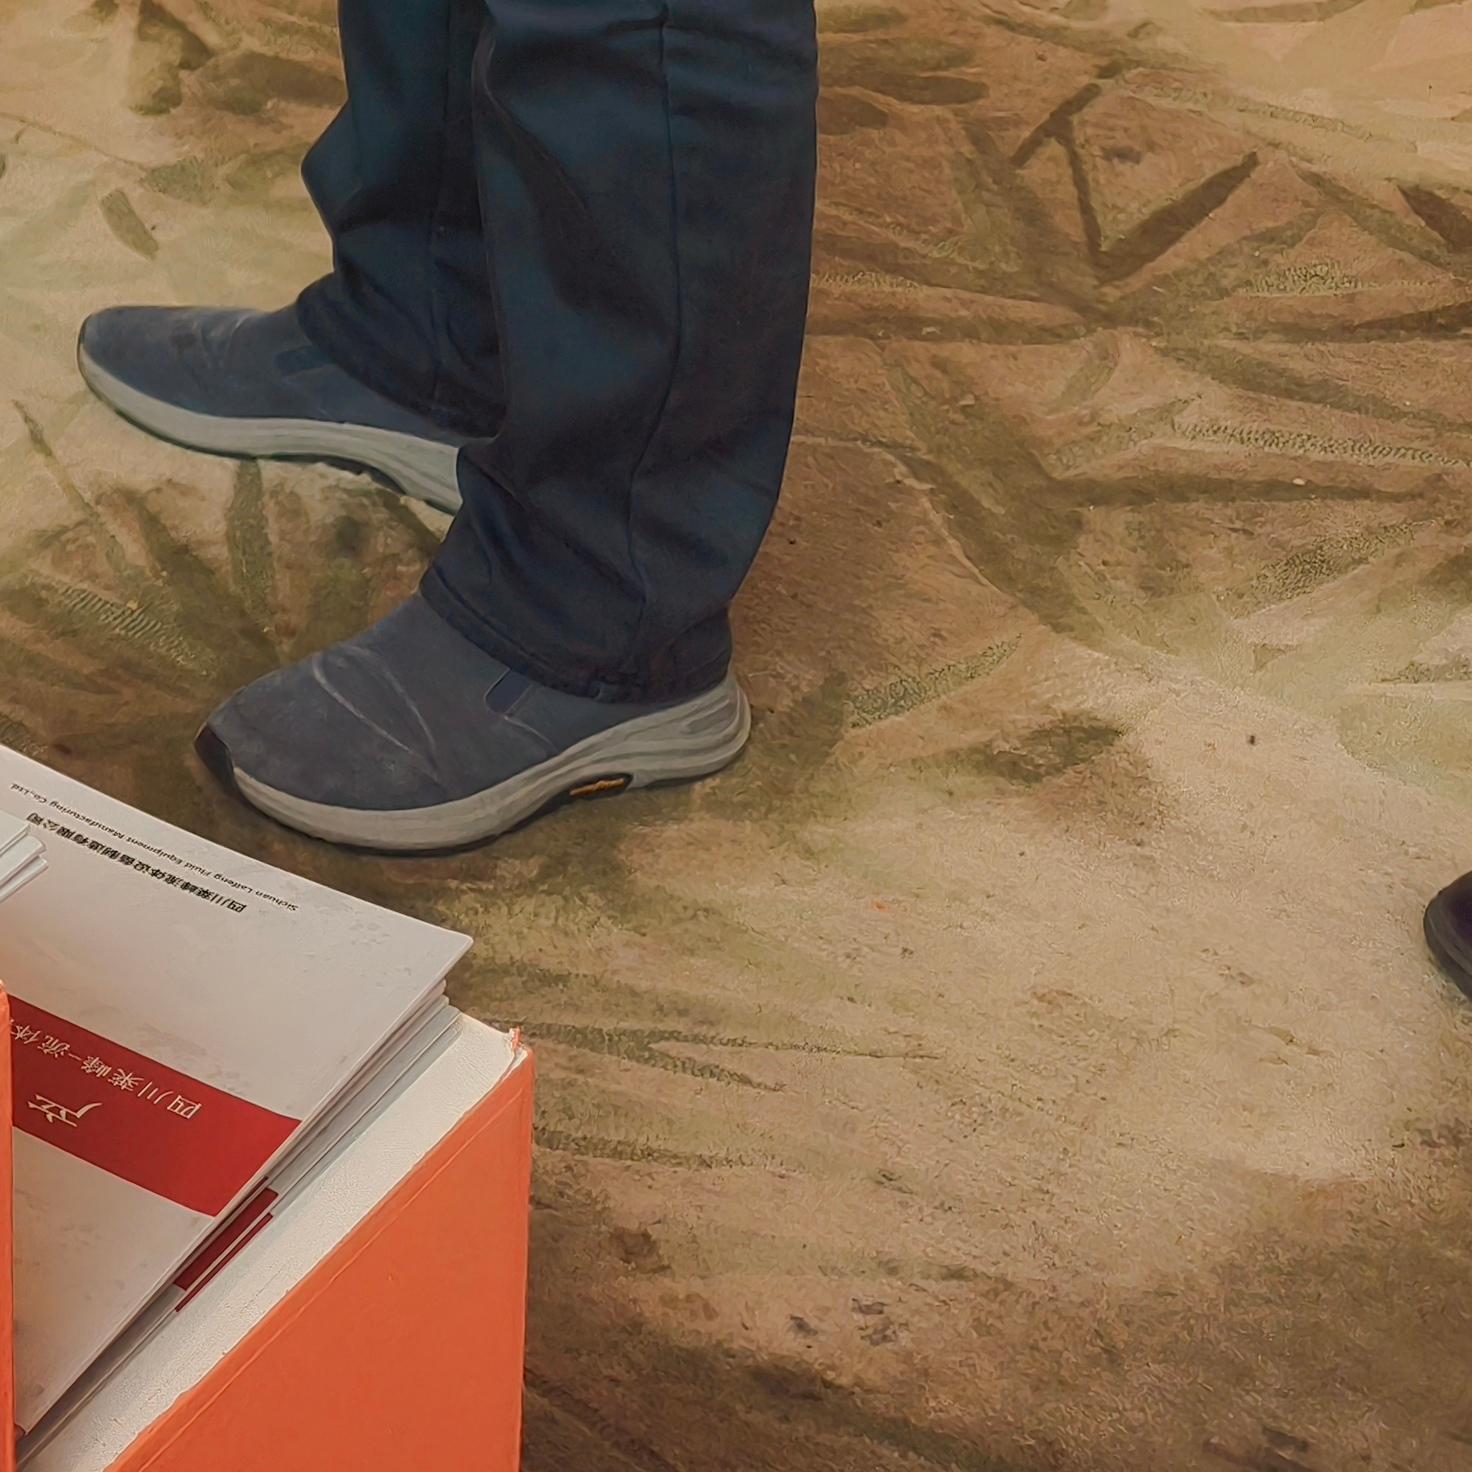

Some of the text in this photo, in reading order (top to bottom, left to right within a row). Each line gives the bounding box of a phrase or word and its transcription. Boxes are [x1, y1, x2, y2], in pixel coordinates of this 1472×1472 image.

[47, 797, 125, 841] Manufacturing
[24, 807, 248, 916] 四川莱峰流体设备制造有限公司
[125, 832, 185, 867] Equipment
[183, 860, 212, 878] Fluid
[211, 869, 254, 895] Laifeng
[253, 888, 299, 914] Sichuan
[8, 1016, 203, 1120] 四川莱峰-流体
[24, 1089, 103, 1129] 产
